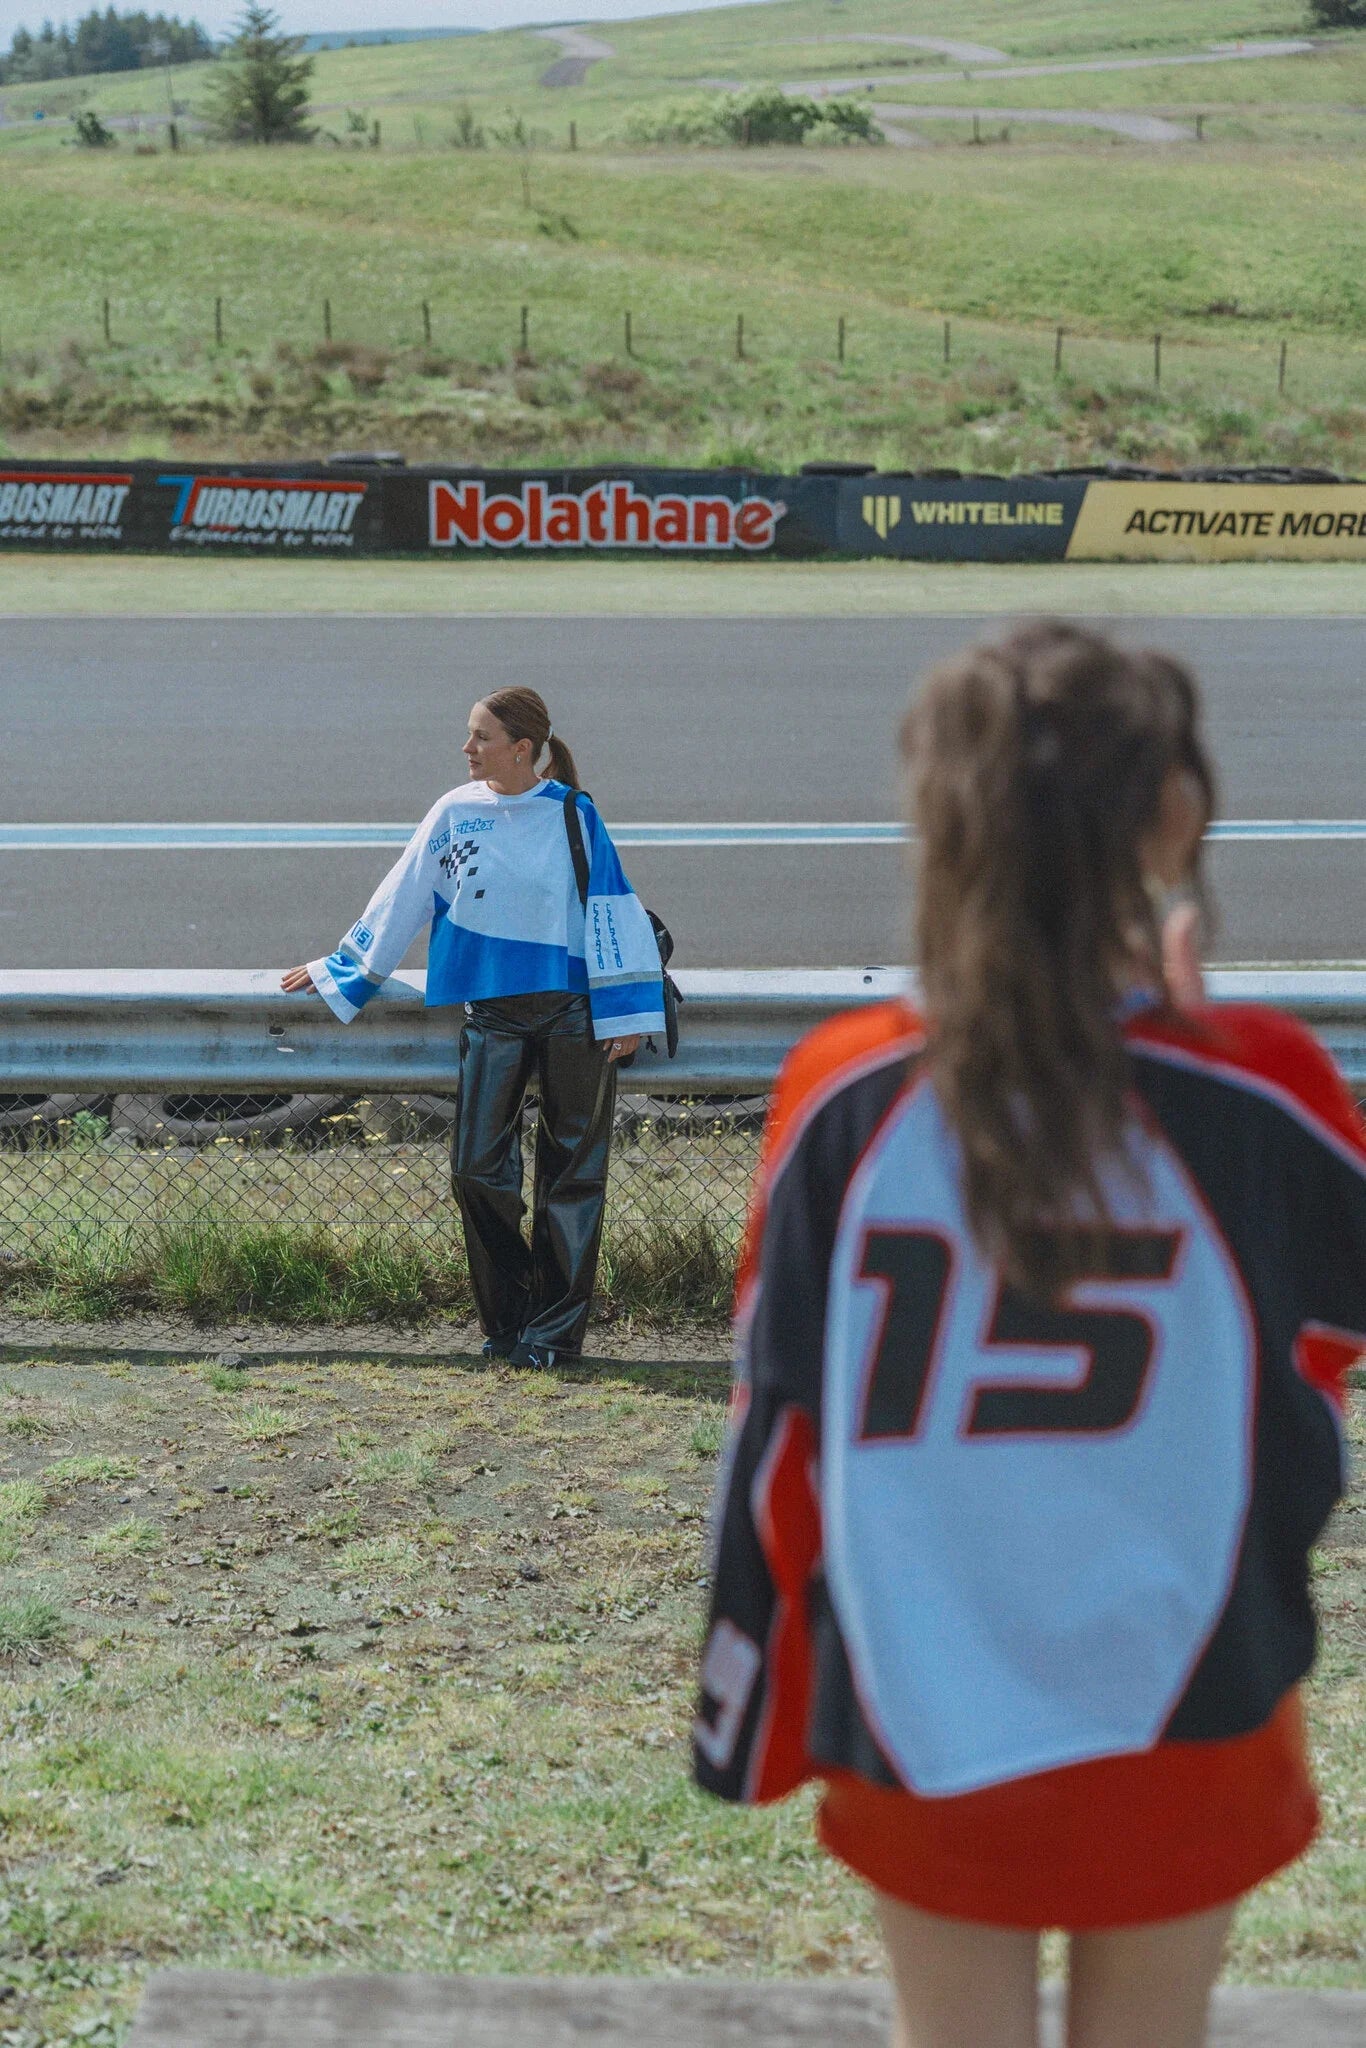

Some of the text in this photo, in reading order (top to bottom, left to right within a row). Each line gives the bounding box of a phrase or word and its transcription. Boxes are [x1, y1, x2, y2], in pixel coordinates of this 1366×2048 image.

[157, 475, 367, 531] TURBOSMART
[430, 480, 782, 550] Nolathane
[910, 502, 1065, 526] WHITELINE
[1125, 508, 1274, 536] ACTIVATE
[429, 818, 495, 855] henrickx
[354, 926, 370, 945] 15
[851, 1222, 1190, 1442] 15
